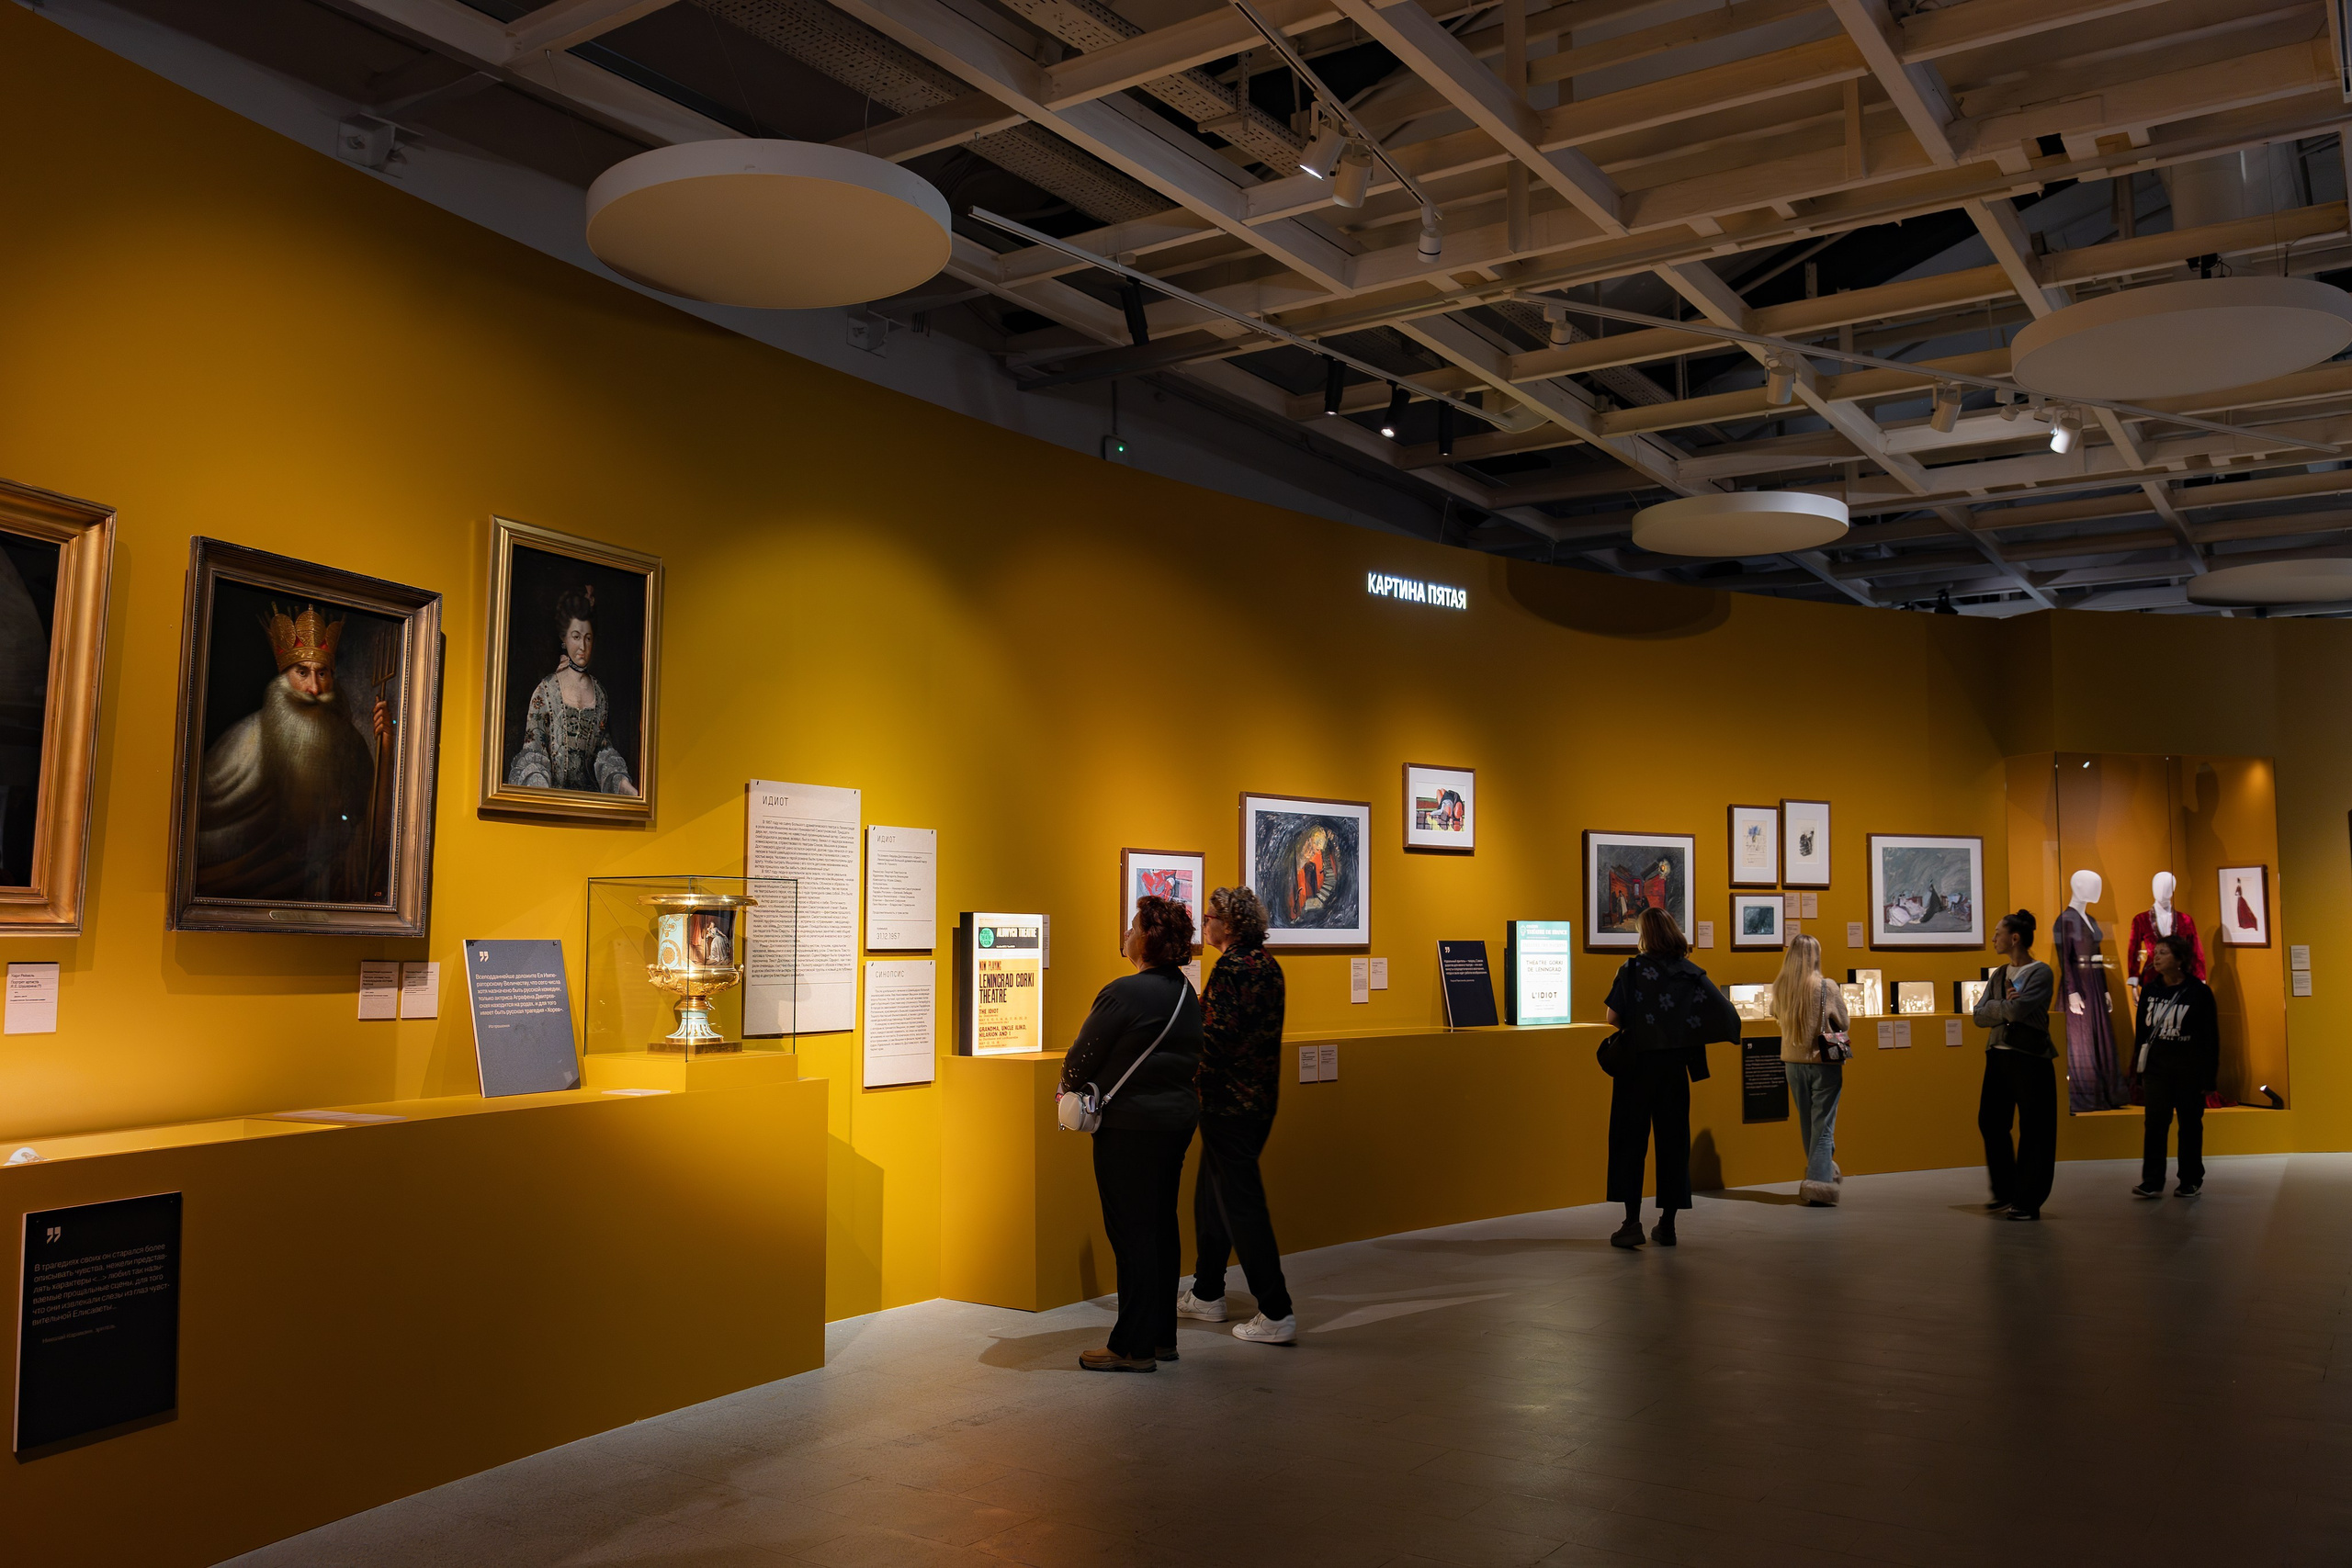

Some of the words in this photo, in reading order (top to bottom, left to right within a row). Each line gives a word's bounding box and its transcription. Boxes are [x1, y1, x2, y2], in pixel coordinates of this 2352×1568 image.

[1368, 572, 1425, 603] КАРТИНА
[1427, 584, 1467, 609] ПЯТАЯ
[762, 796, 789, 806] ИДИОТ
[979, 973, 1014, 988] LENINGRAD
[1016, 973, 1034, 987] GORKI
[988, 961, 1001, 971] PLAYING
[979, 989, 1007, 1003] THEATRE
[34, 1263, 40, 1272] В
[42, 1259, 79, 1272] трагедиях
[80, 1255, 101, 1264] своих
[112, 1248, 144, 1260] старался
[145, 1243, 165, 1253] более
[34, 1270, 74, 1283] описывать
[106, 1256, 133, 1270] нежели
[134, 1254, 167, 1266] представ-
[33, 1285, 51, 1294] лять
[52, 1274, 91, 1292] характеры
[108, 1269, 131, 1279] любил
[132, 1264, 143, 1275] так
[144, 1261, 164, 1273] назы-
[33, 1290, 62, 1305] ваемые
[63, 1281, 110, 1300] прощальные
[135, 1277, 148, 1286] для
[149, 1274, 163, 1282] того
[32, 1307, 45, 1315] что
[46, 1304, 60, 1313] они
[61, 1293, 101, 1310] извлекали
[134, 1287, 148, 1295] глаз
[149, 1283, 170, 1294] чувст-
[32, 1311, 72, 1326] вительной
